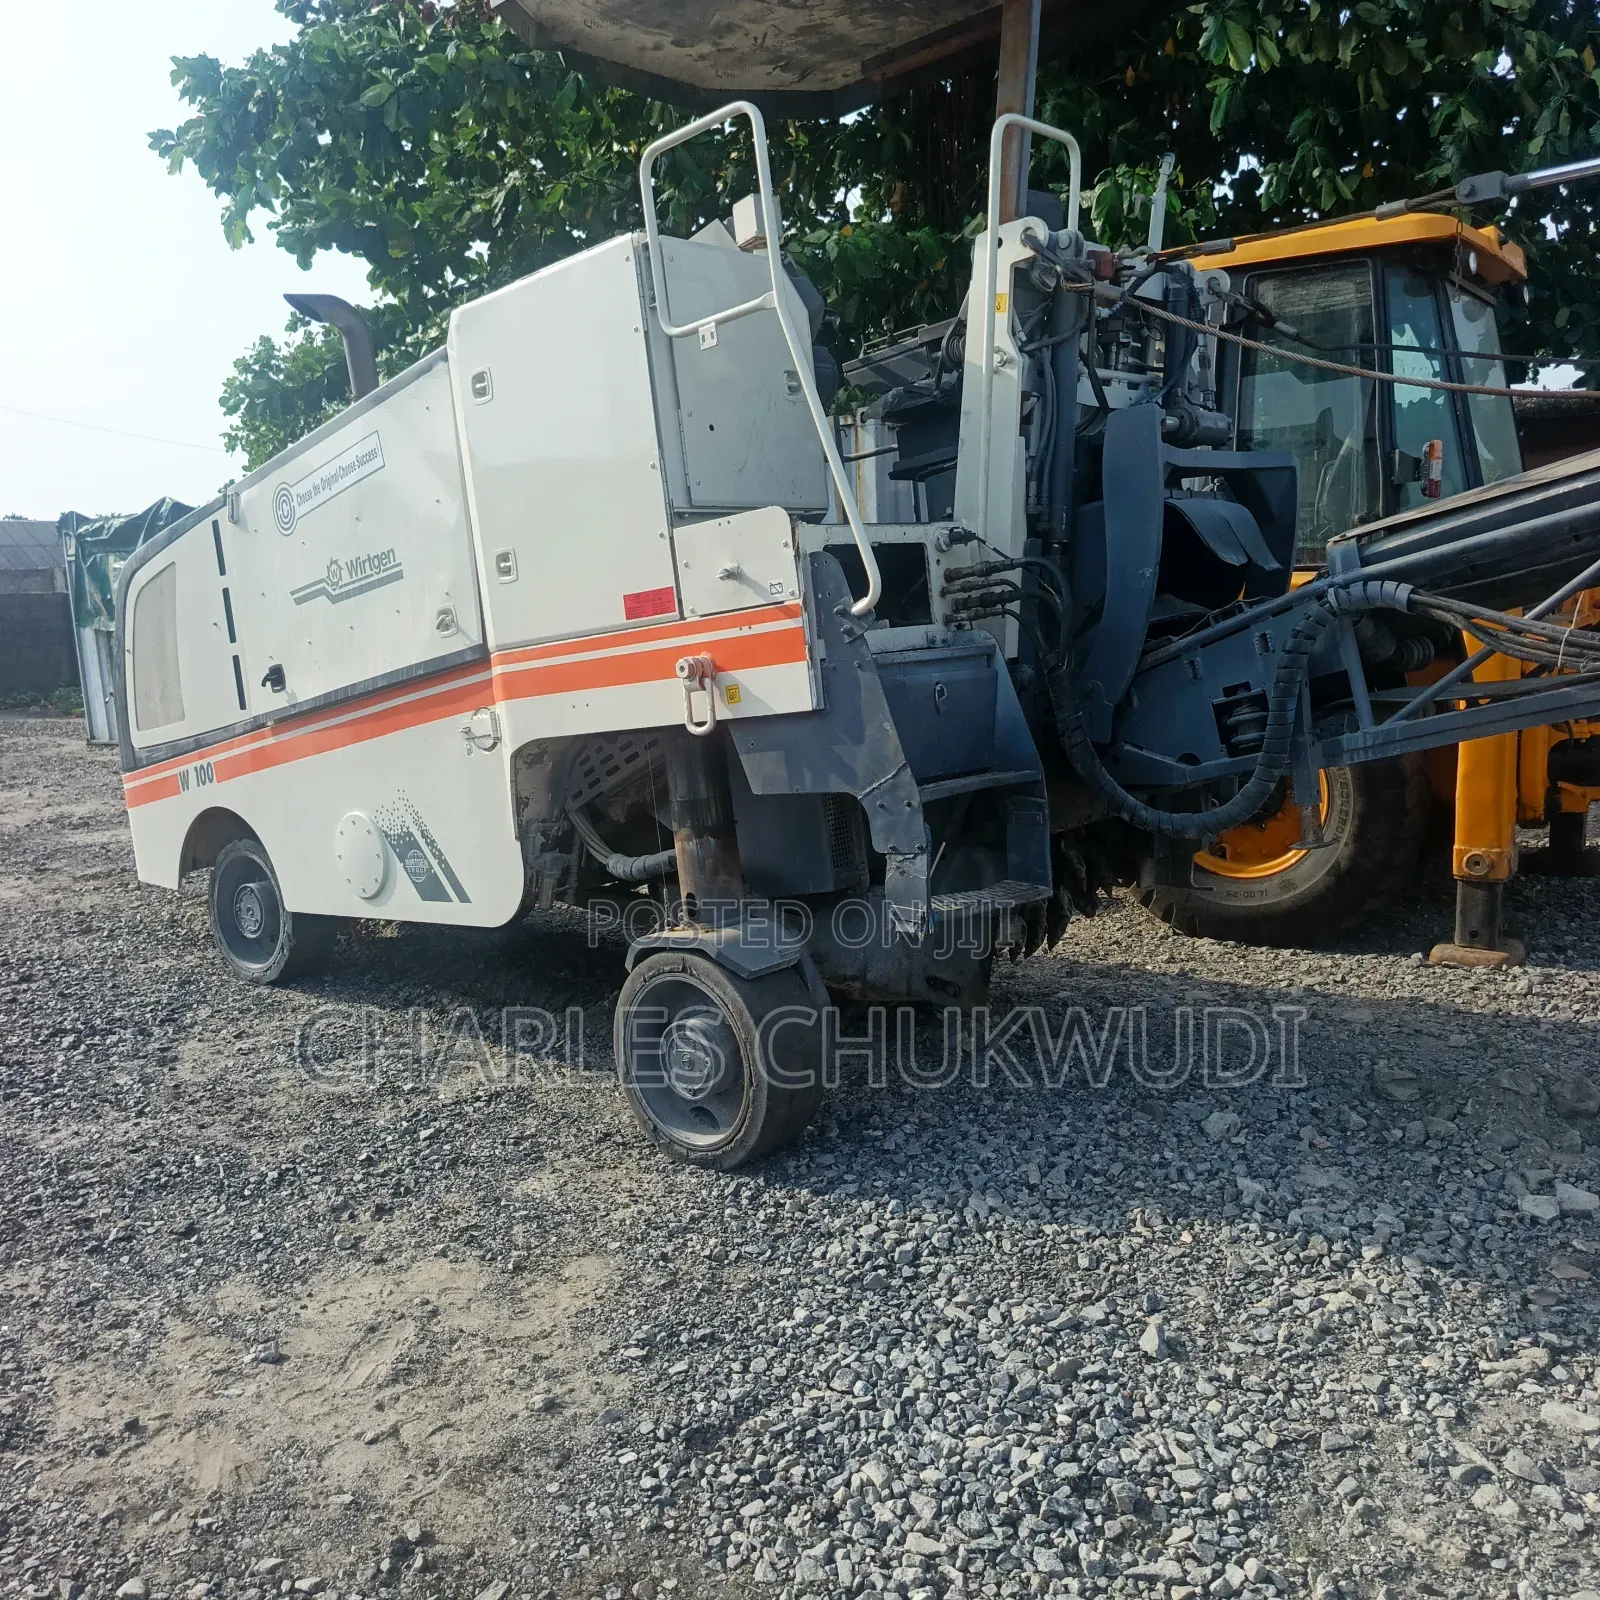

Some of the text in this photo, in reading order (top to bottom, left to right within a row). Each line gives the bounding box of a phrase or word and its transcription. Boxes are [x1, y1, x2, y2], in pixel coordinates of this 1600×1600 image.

[296, 489, 313, 507] Choose
[312, 482, 321, 497] the
[345, 548, 397, 580] Wirtgen
[178, 761, 215, 793] W 100
